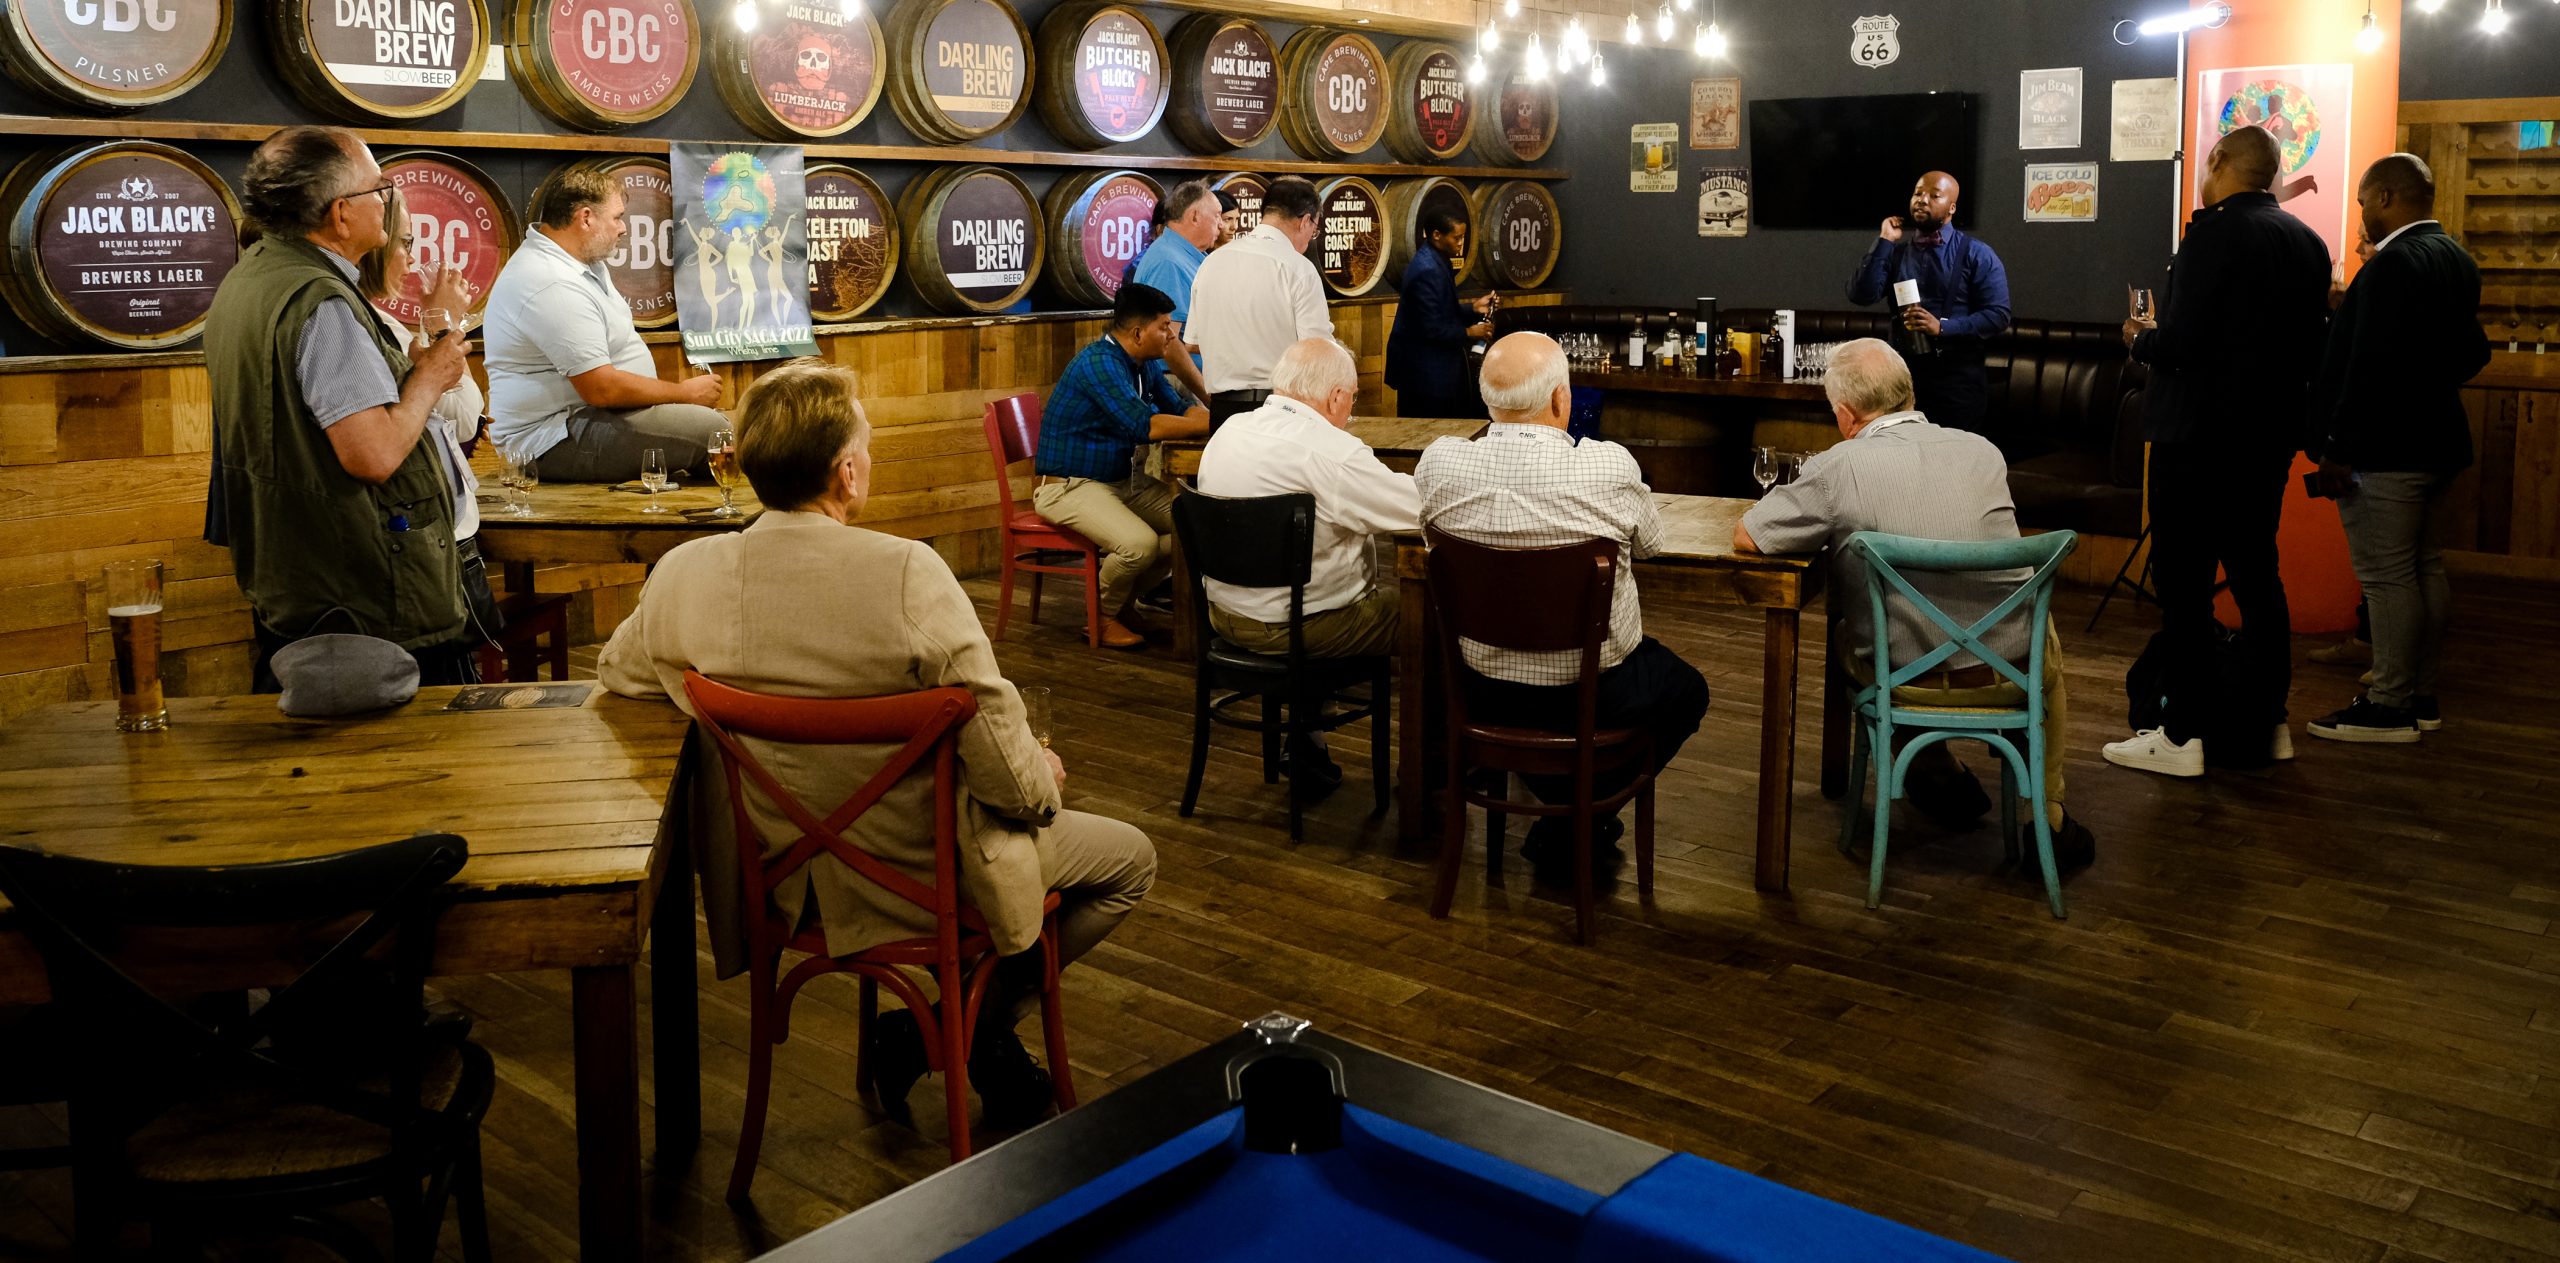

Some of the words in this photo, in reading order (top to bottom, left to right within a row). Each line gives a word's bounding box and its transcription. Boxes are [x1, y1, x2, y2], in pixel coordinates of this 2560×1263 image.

[336, 0, 455, 35] DARLING
[786, 4, 811, 21] JACK
[582, 7, 660, 64] CBC
[1862, 21, 1890, 30] ROUTE
[1097, 31, 1115, 43] JACK
[375, 30, 455, 67] BREW
[938, 40, 1013, 71] DARLING
[1861, 42, 1889, 61] 66
[75, 57, 168, 83] PILSNER
[1086, 45, 1151, 75] BUTCHER
[1210, 56, 1236, 75] JACK
[1319, 55, 1334, 82] CAPE
[1334, 45, 1369, 67] BREWING
[1368, 69, 1376, 85] CO
[962, 68, 1013, 97] BREW
[1101, 68, 1136, 88] BLOCK
[1427, 67, 1440, 78] JACK
[571, 69, 622, 105] AMBER
[629, 73, 672, 105] WEISS
[1328, 74, 1367, 114] CBC
[1420, 79, 1464, 103] BUTCHER
[2028, 83, 2046, 100] JIM
[2047, 79, 2074, 97] BEAM
[774, 92, 847, 112] LUMBERJACK
[1216, 97, 1243, 108] BREWERS
[1245, 99, 1264, 109] LAGER
[1430, 98, 1454, 114] BLOCK
[2033, 114, 2067, 123] BLACK
[1331, 127, 1364, 143] PILSNER
[2032, 170, 2053, 181] ICE
[2056, 169, 2092, 180] COLD
[625, 175, 672, 197] REWIN
[1700, 176, 1748, 195] MUSTANG
[393, 170, 476, 204] BREWING
[475, 206, 492, 231] CO
[1088, 196, 1108, 227] CAPE
[1109, 185, 1154, 208] BREWING
[1332, 200, 1346, 212] JACK
[2028, 181, 2095, 214] Beer
[61, 206, 126, 234] JACK
[1502, 201, 1515, 226] CAPE
[1514, 193, 1544, 211] BREWING
[1542, 212, 1550, 227] CO
[952, 218, 1024, 246] DARLING
[1324, 217, 1371, 233] SKELETON
[1509, 217, 1541, 252] CBC
[99, 240, 139, 249] BREWING
[142, 239, 183, 247] COMPANY
[410, 213, 470, 273] BC
[806, 240, 840, 262] AST
[1324, 234, 1355, 251] COAST
[975, 243, 1024, 271] BREW
[1324, 252, 1342, 268] IPA
[81, 270, 152, 285] BREWERS
[158, 269, 204, 283] LAGER
[1093, 266, 1122, 291] AMBE
[1511, 265, 1537, 278] PILSNER
[129, 298, 161, 308] Original
[388, 299, 421, 317] BER
[627, 290, 675, 310] LSNER
[685, 332, 714, 348] Sun
[715, 329, 741, 347] City
[743, 328, 775, 344] SACA
[778, 326, 812, 343] 2022
[759, 345, 779, 353] Time
